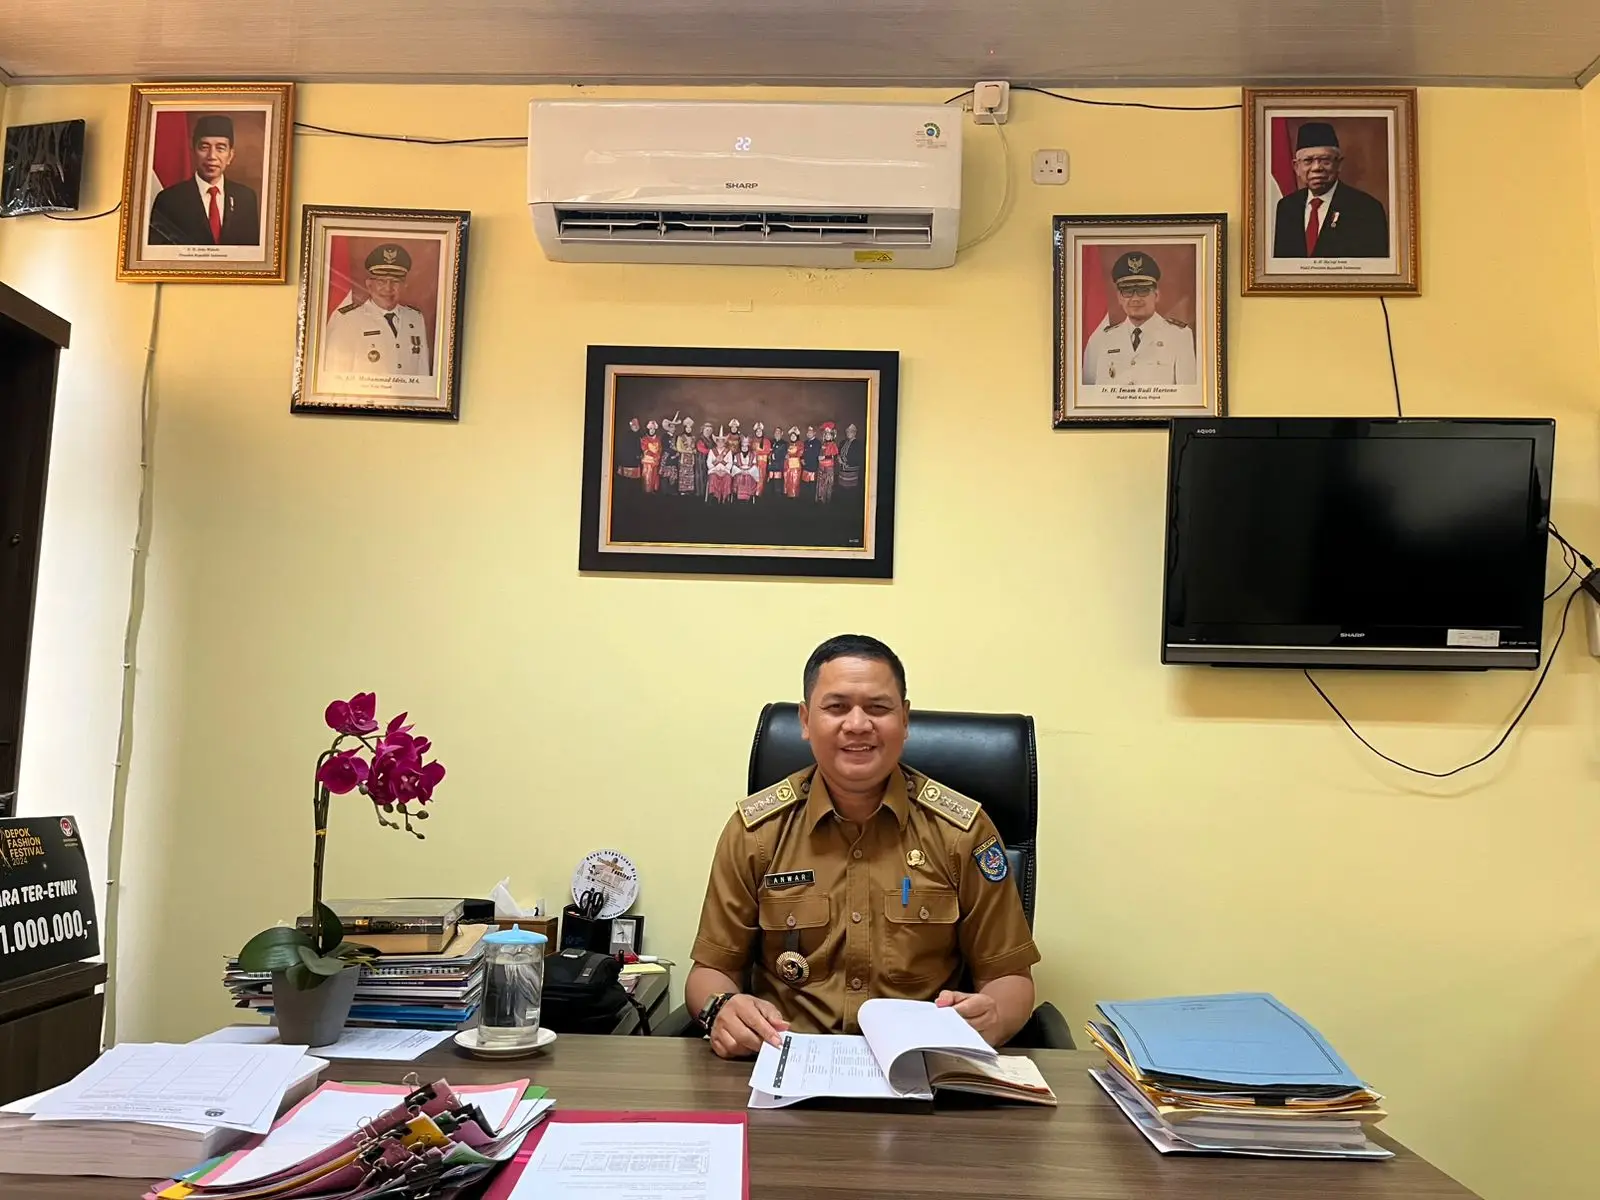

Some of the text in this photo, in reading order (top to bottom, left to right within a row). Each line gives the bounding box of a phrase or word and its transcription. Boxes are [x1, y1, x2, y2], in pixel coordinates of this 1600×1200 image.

[735, 136, 752, 151] 22
[4, 828, 31, 839] DEPOK
[7, 837, 41, 849] FASHION
[9, 846, 45, 858] FESTIVAL
[773, 873, 806, 884] ANWAR
[0, 879, 78, 907] RA TER-ETNIK
